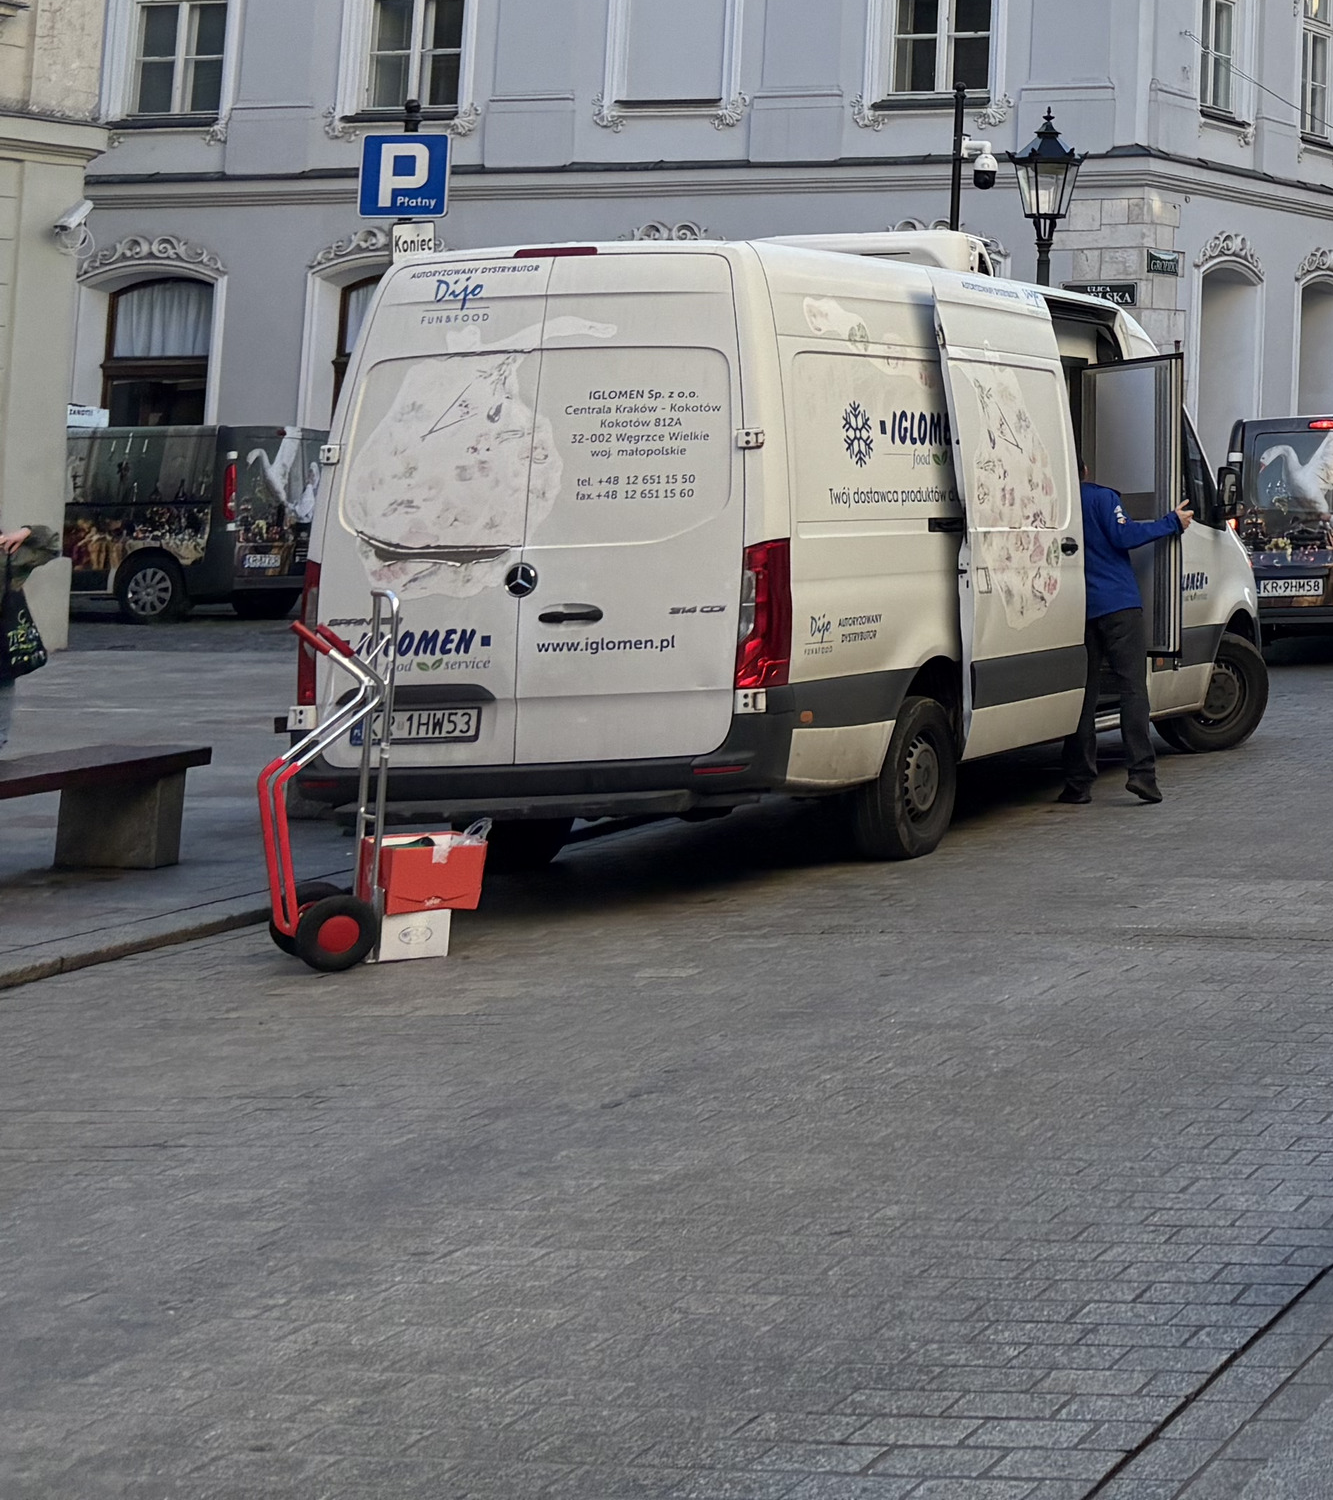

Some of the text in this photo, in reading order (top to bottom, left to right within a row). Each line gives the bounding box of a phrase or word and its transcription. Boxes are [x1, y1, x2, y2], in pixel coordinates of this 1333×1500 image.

[378, 143, 429, 207] P
[396, 196, 437, 209] Płatny
[394, 234, 433, 253] Koniec
[410, 264, 540, 279] AUTORYZOWANY DYSTRYBUTOR
[434, 276, 484, 311] Dijo
[588, 389, 699, 401] IGLOMEN Sp. z o.o.
[564, 405, 612, 415] Centrala
[615, 404, 658, 414] Kraków
[669, 403, 722, 413] Kokotów
[600, 417, 682, 429] Kokotów 812A
[571, 431, 710, 445] 32-002 Węgrzce Wielkie
[617, 446, 687, 459] małopolskie
[912, 449, 931, 469] food
[577, 474, 696, 487] tel. +48 12 651 15 50
[596, 490, 618, 499] +48
[624, 489, 637, 499] 12
[640, 489, 660, 499] 651
[663, 488, 676, 498] 15
[679, 488, 695, 498] 60
[829, 486, 851, 508] Twój
[853, 487, 899, 504] dostawca
[901, 485, 946, 506] produktów
[1263, 580, 1321, 593] KR 9HM58
[669, 604, 727, 614] 314 CDI
[810, 613, 832, 644] Dijo
[536, 635, 676, 654] www.iglomen.pl
[443, 659, 491, 670] service
[406, 712, 472, 736] 1HW53
